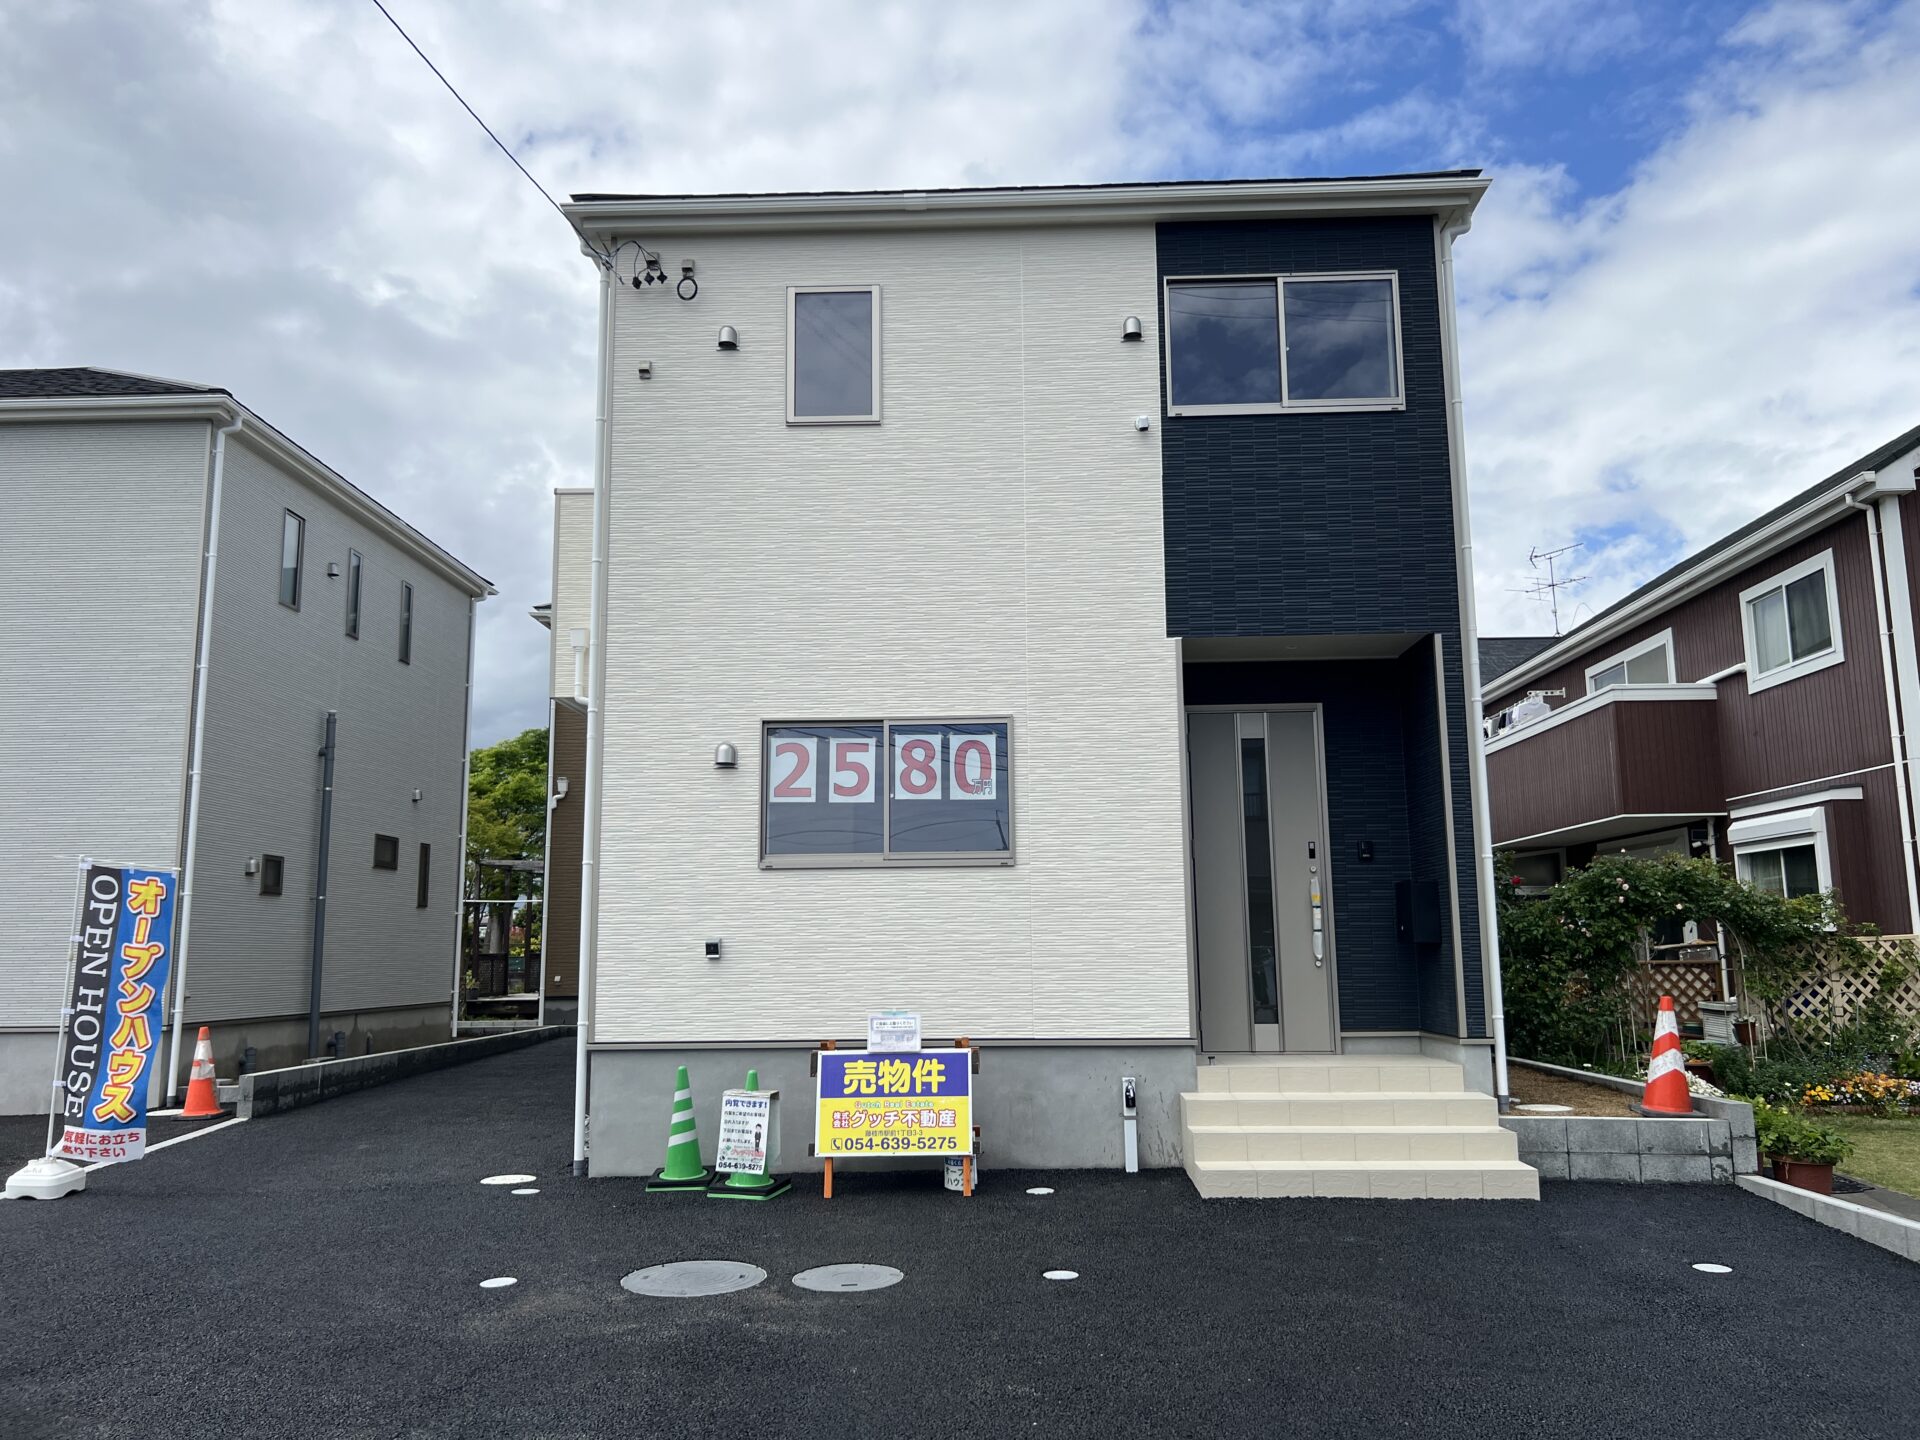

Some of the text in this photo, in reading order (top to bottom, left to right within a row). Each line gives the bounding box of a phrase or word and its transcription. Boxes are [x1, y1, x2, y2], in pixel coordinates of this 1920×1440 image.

[774, 739, 992, 797] 2580
[64, 875, 119, 1118] OPEN HOUSE
[92, 876, 166, 1123] オープンハウス
[843, 1058, 946, 1094] 売物件
[906, 1100, 934, 1108] Estate
[851, 1109, 956, 1128] グッチ不動産
[844, 1137, 957, 1150] 054-639-5275
[718, 1162, 763, 1171] 054-639-5275
[947, 1178, 964, 1187] ハウ
